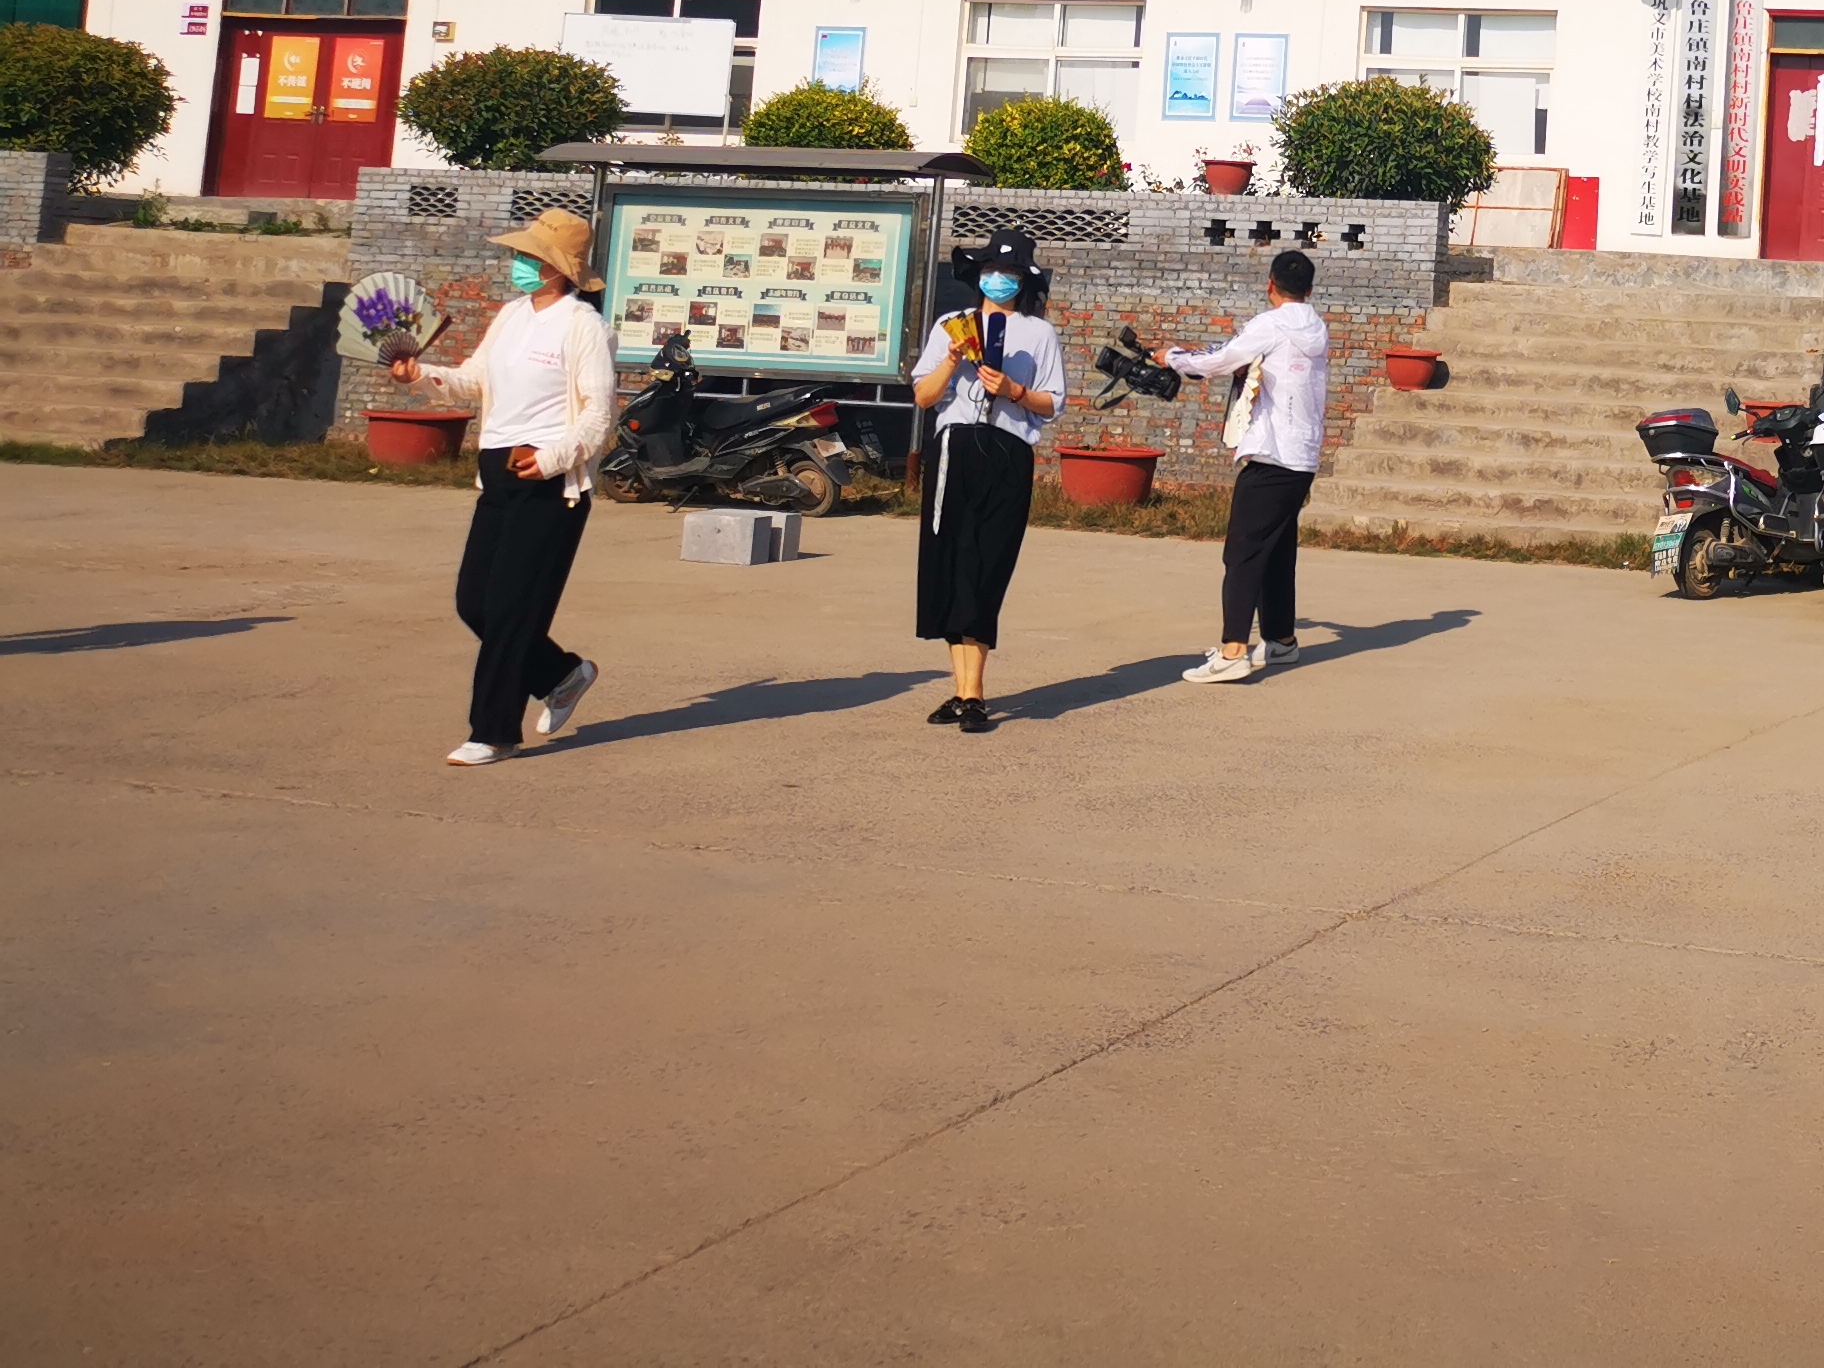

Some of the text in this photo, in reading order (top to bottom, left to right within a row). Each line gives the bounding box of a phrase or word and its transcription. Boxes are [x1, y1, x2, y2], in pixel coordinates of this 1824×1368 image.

[1677, 0, 1711, 223] 鲁庄镇南村村法治文化基地
[1721, 0, 1755, 223] 鲁庄镇南村村新时代文明实践站
